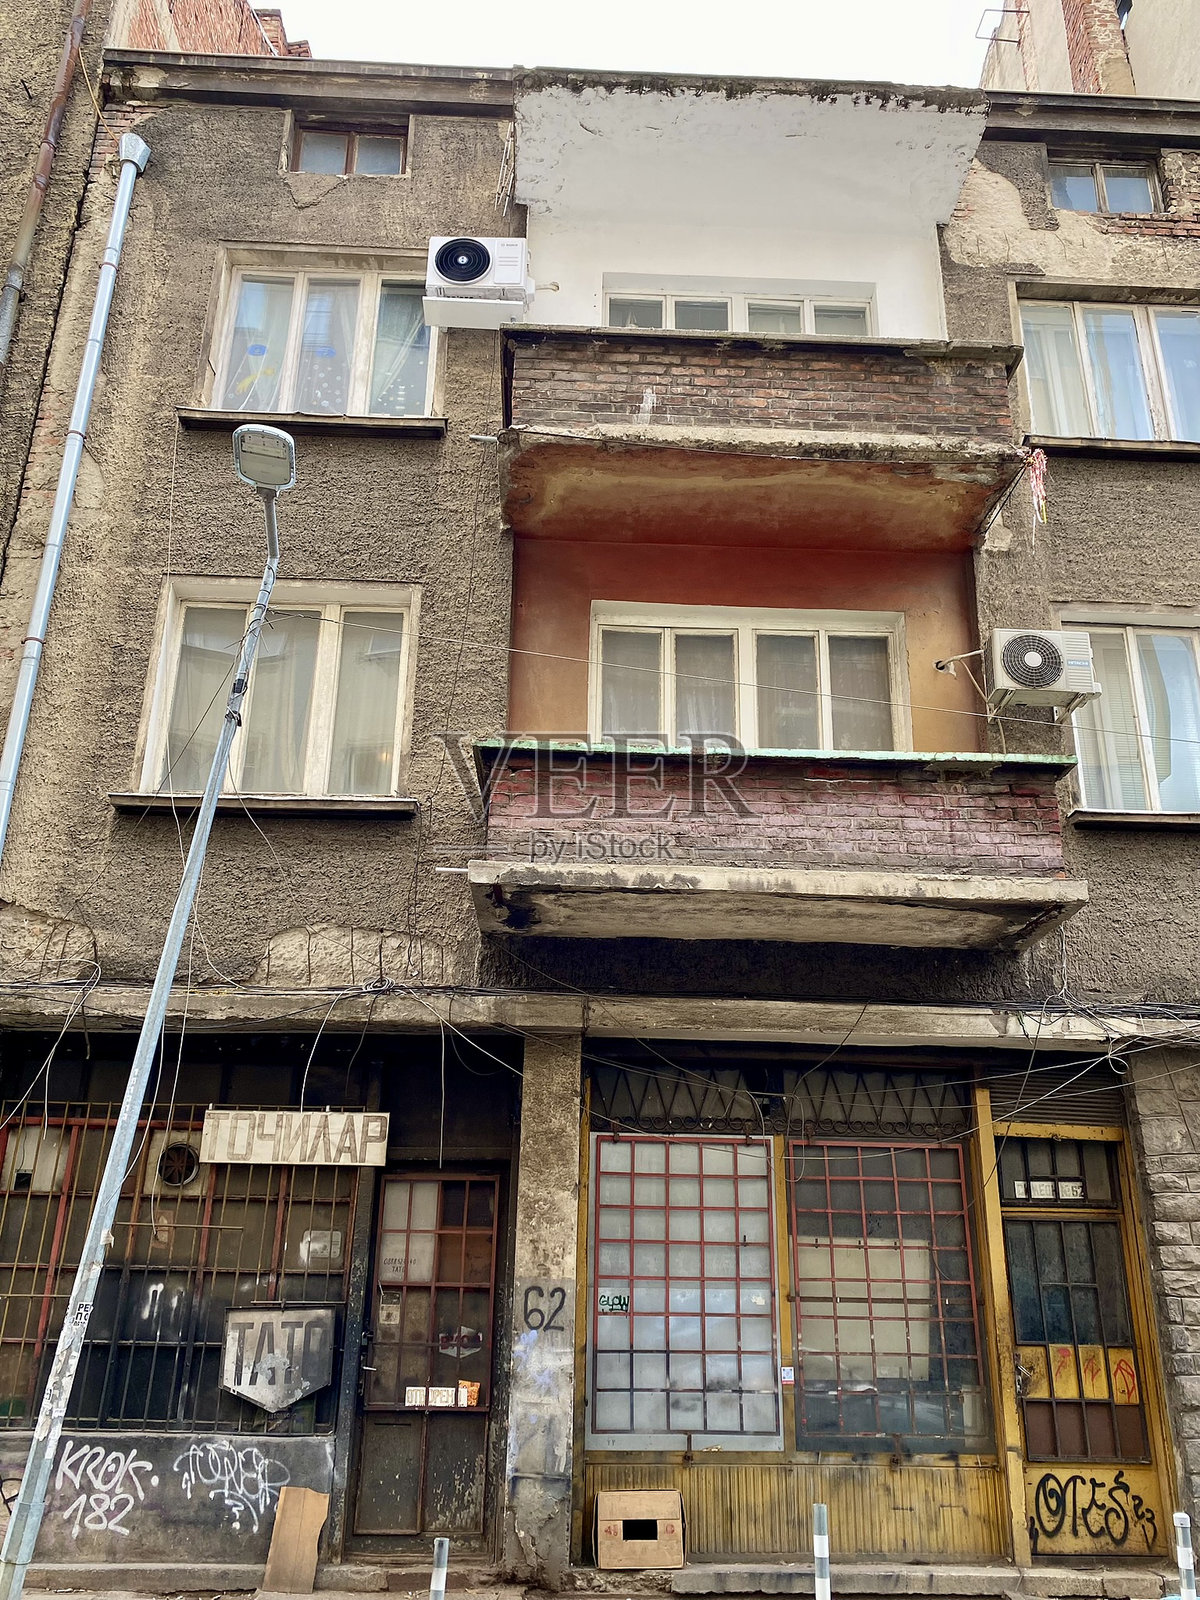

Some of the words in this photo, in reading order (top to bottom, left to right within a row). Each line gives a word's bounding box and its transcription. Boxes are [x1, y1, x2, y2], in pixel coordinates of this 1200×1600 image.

[205, 1112, 388, 1163] ТОЧИЛАР
[523, 1285, 566, 1332] 62
[231, 1321, 330, 1387] ТАТО
[63, 1493, 135, 1540] 182
